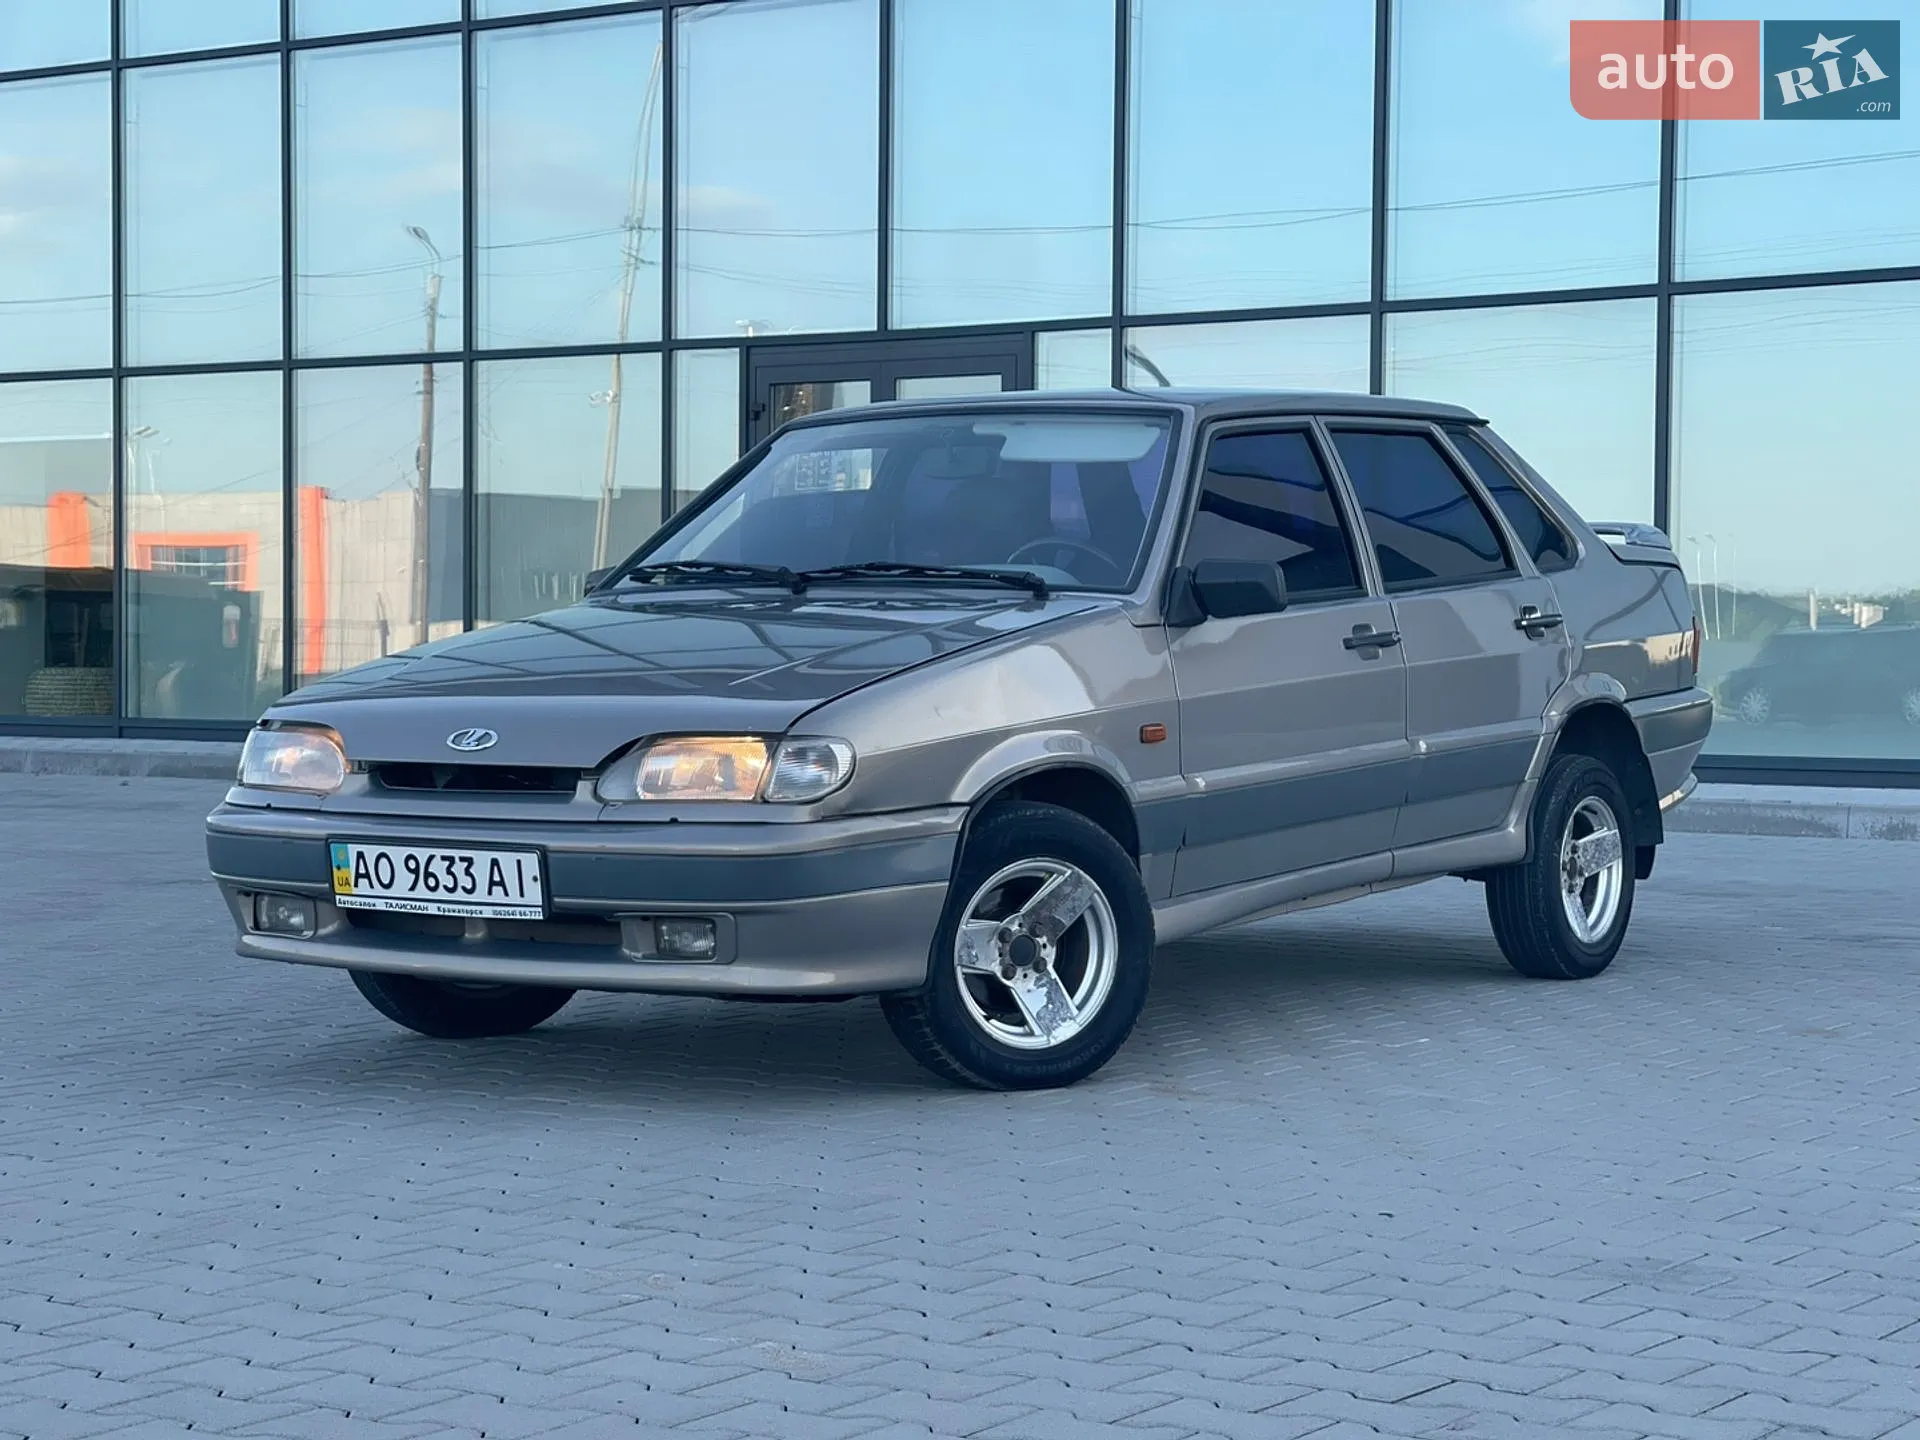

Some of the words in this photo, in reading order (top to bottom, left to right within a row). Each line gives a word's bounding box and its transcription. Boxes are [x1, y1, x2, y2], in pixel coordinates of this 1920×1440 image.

[353, 850, 396, 891] AO
[403, 853, 478, 895] 9633
[337, 875, 352, 888] UA
[384, 901, 430, 912] ТАЛИСМАН
